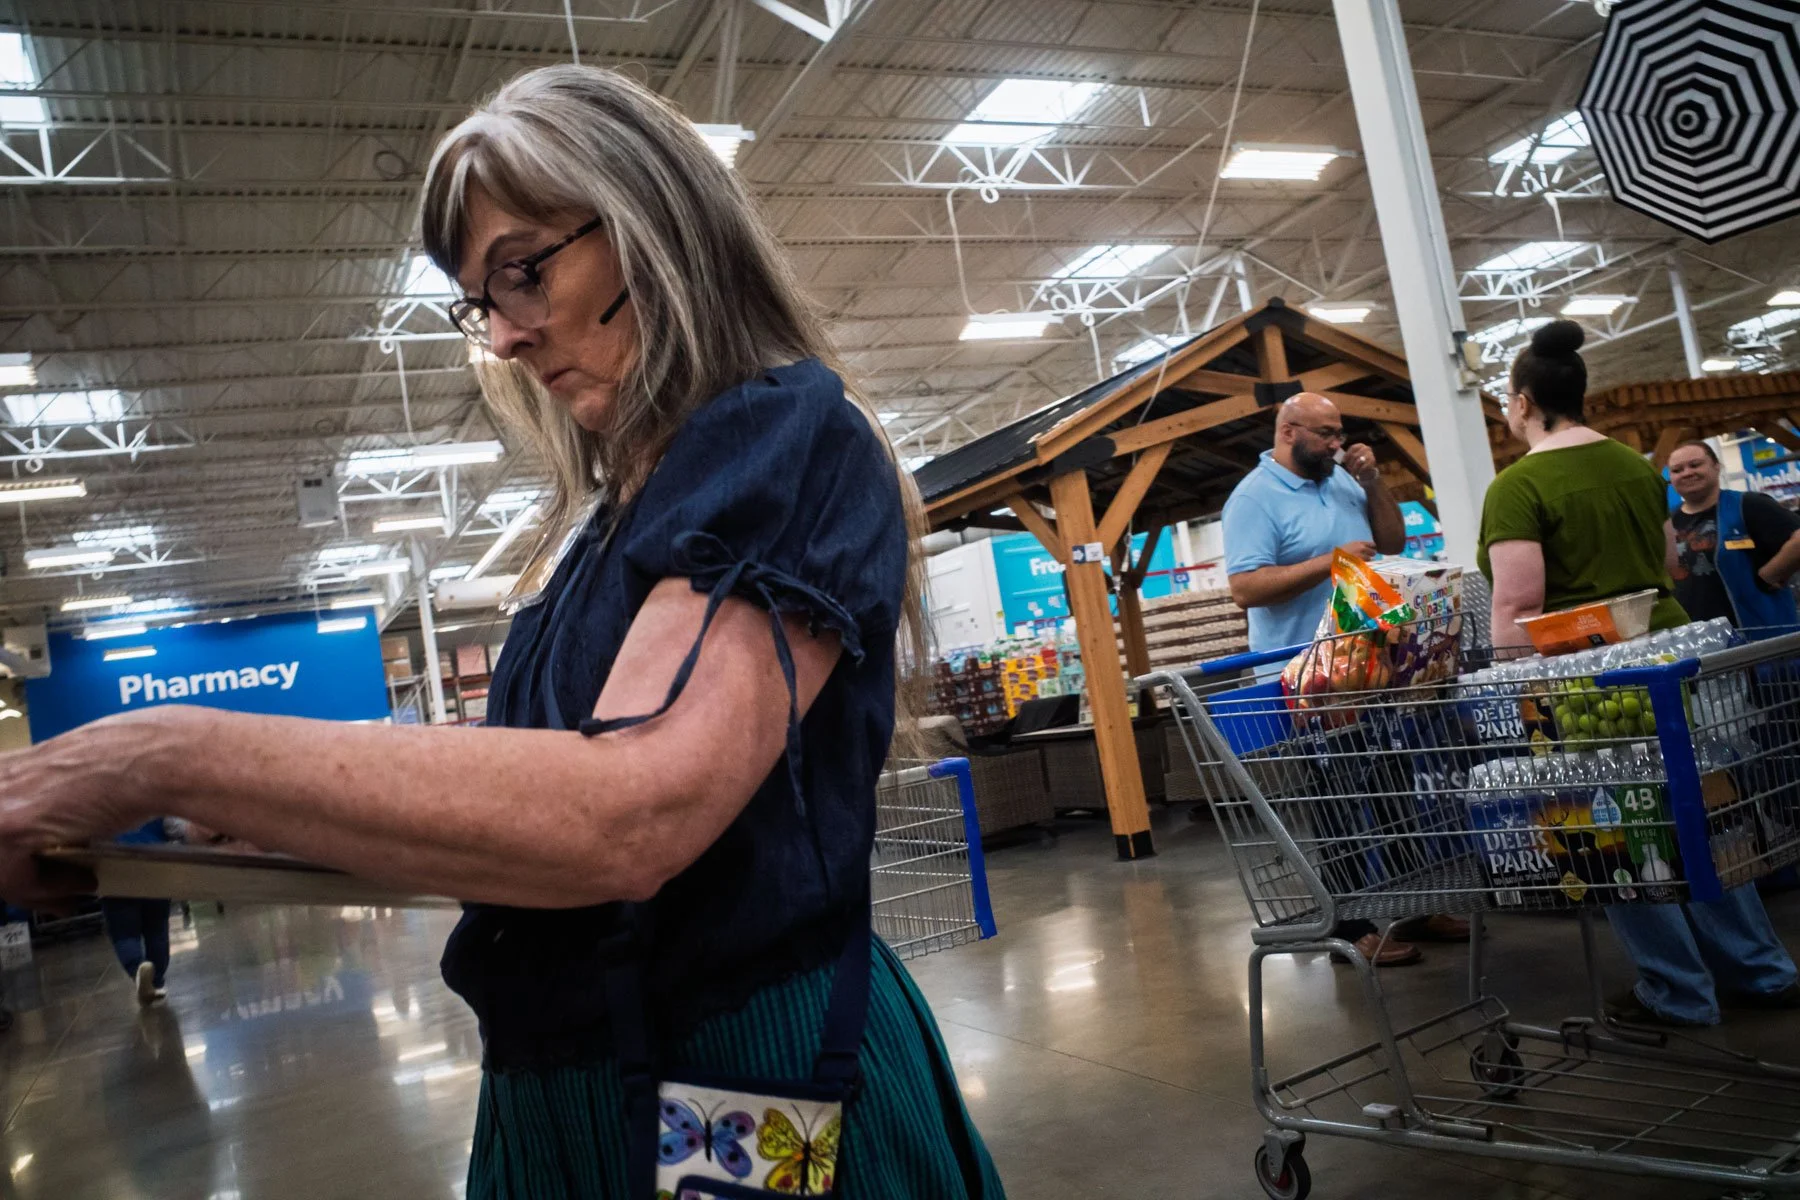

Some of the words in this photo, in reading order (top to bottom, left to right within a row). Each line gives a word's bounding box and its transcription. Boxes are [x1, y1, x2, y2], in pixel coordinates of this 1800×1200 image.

[119, 661, 299, 704] Pharmacy
[1477, 718, 1526, 739] PARK
[1484, 826, 1548, 851] DEER
[1488, 848, 1555, 874] PARK
